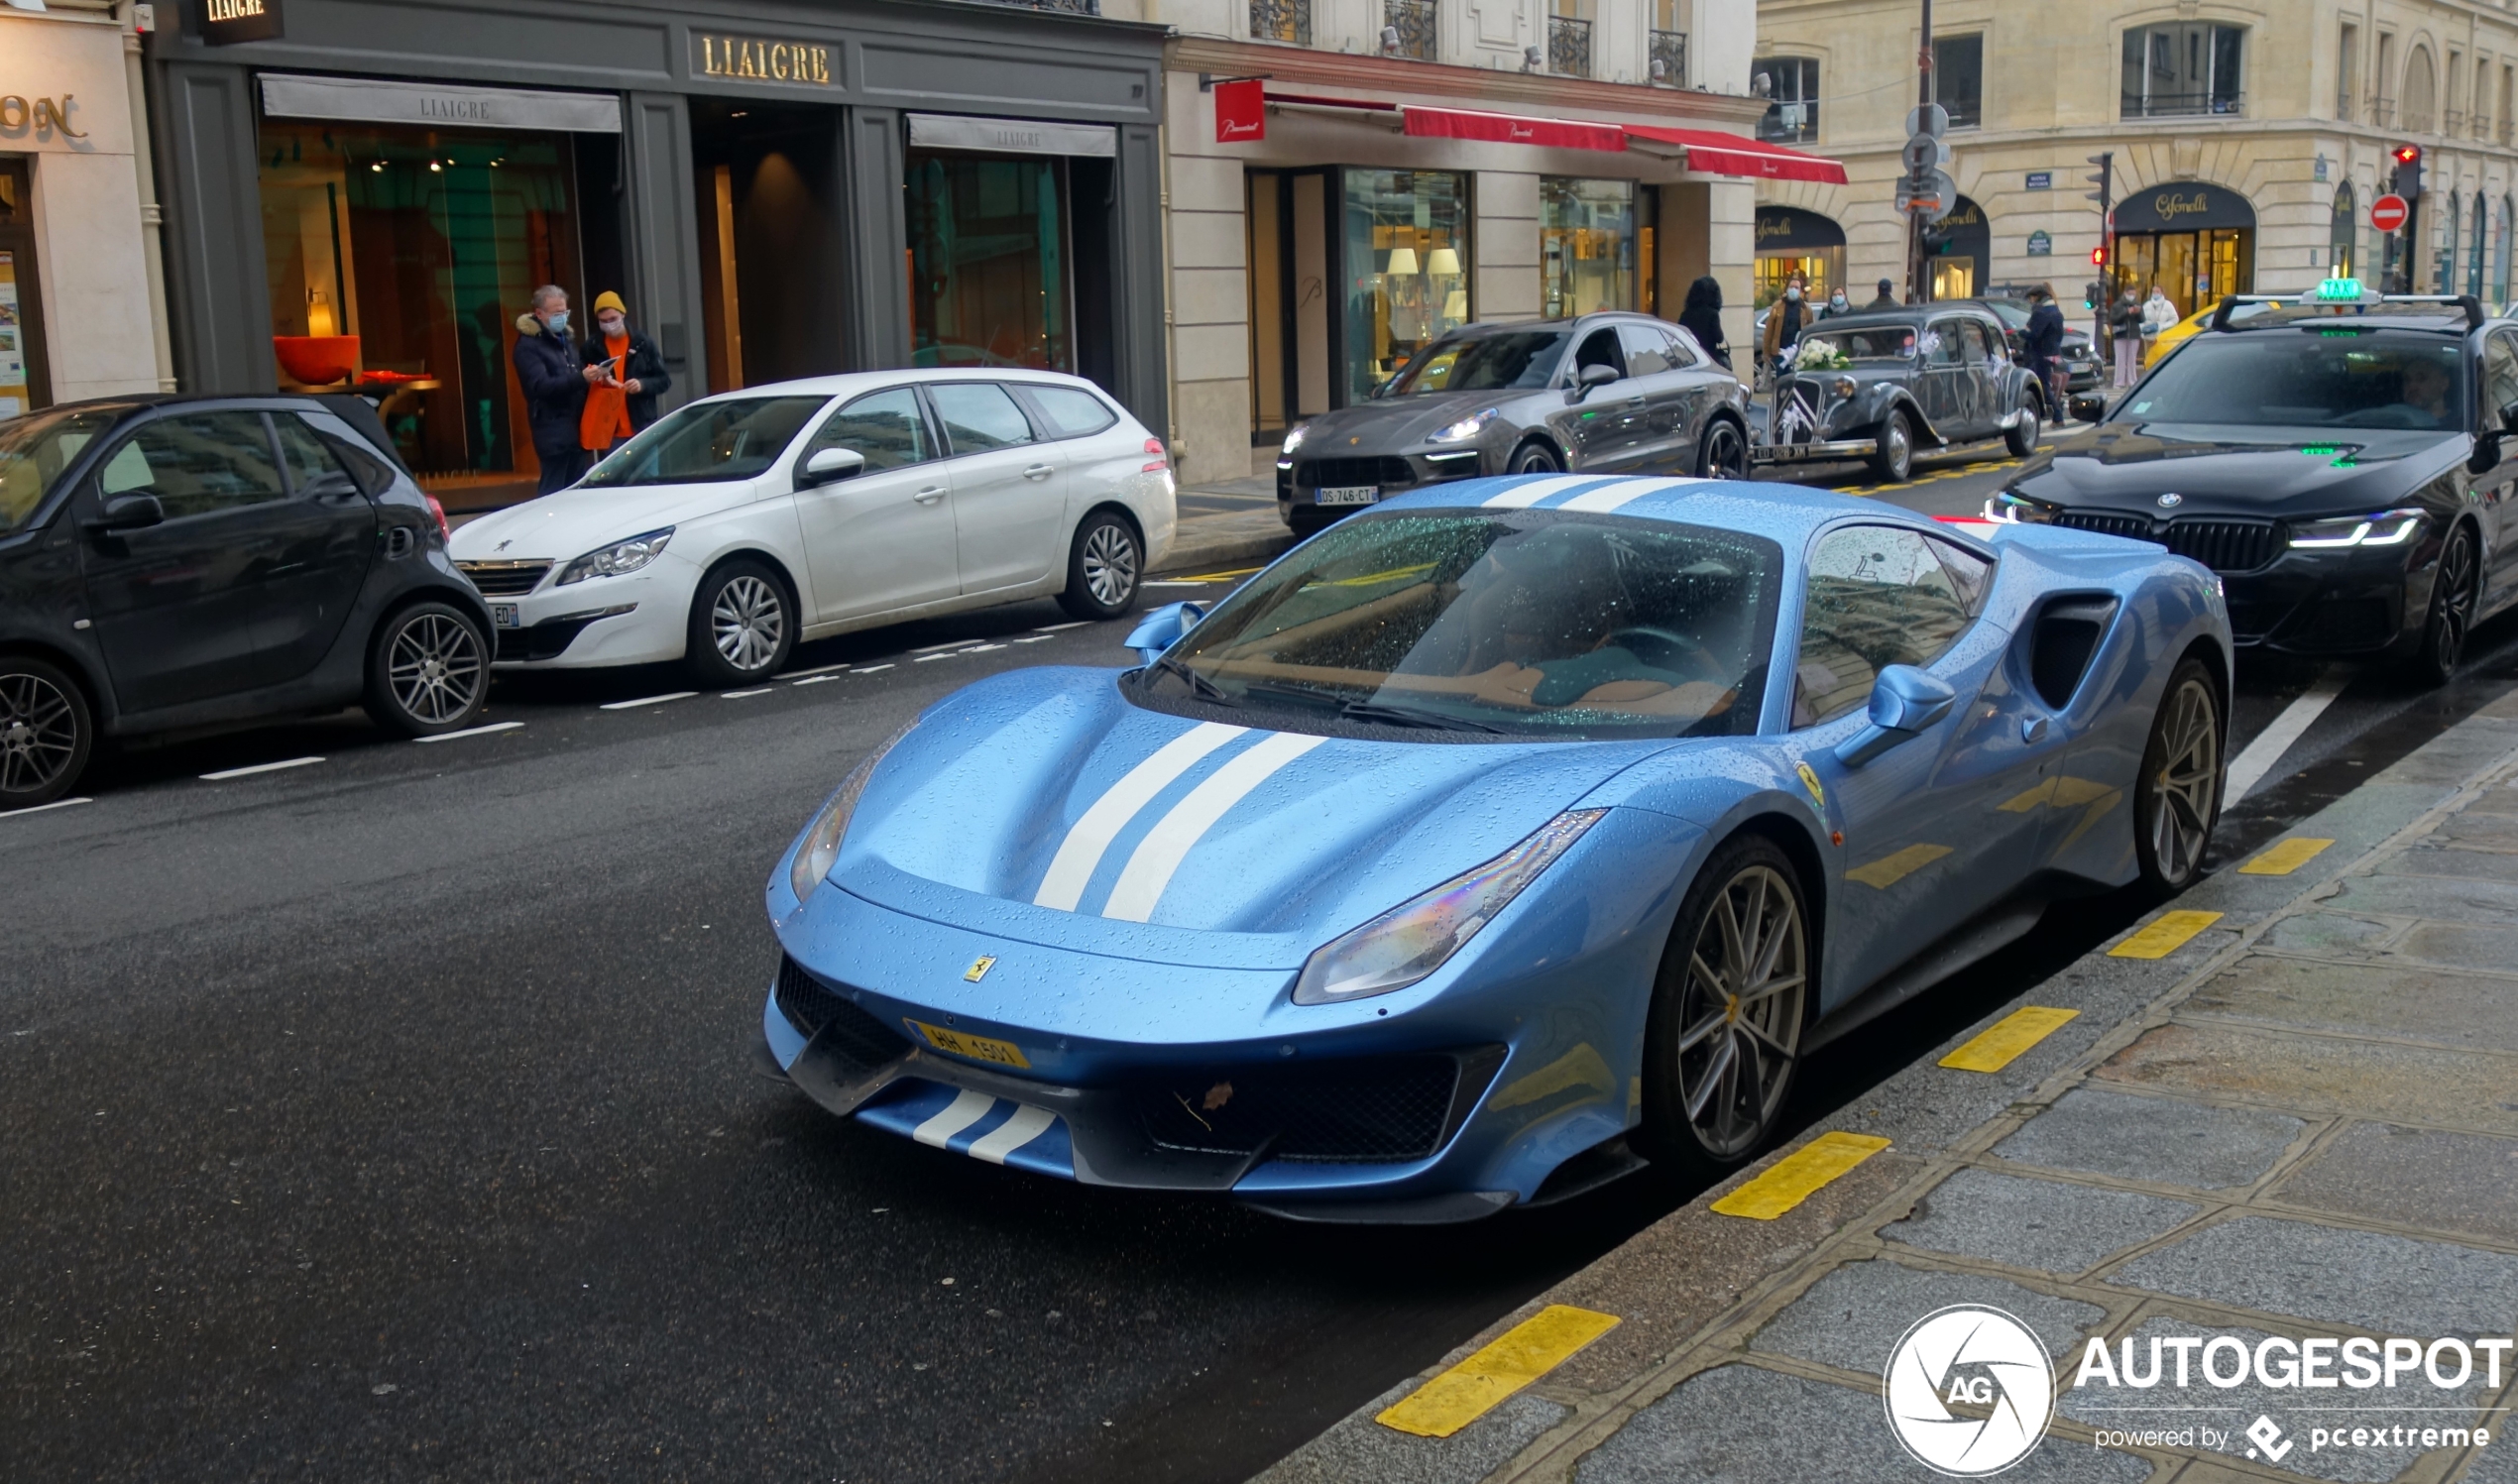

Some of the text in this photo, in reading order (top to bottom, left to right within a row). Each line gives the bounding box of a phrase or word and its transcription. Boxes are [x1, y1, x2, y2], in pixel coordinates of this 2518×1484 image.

[703, 37, 830, 83] LIAIGRE
[420, 98, 490, 120] LIAIGRE
[997, 131, 1041, 147] LIAIGRE
[2324, 281, 2360, 296] TAXI
[1322, 489, 1370, 503] DS-746-CT
[972, 1039, 1016, 1063] 1501
